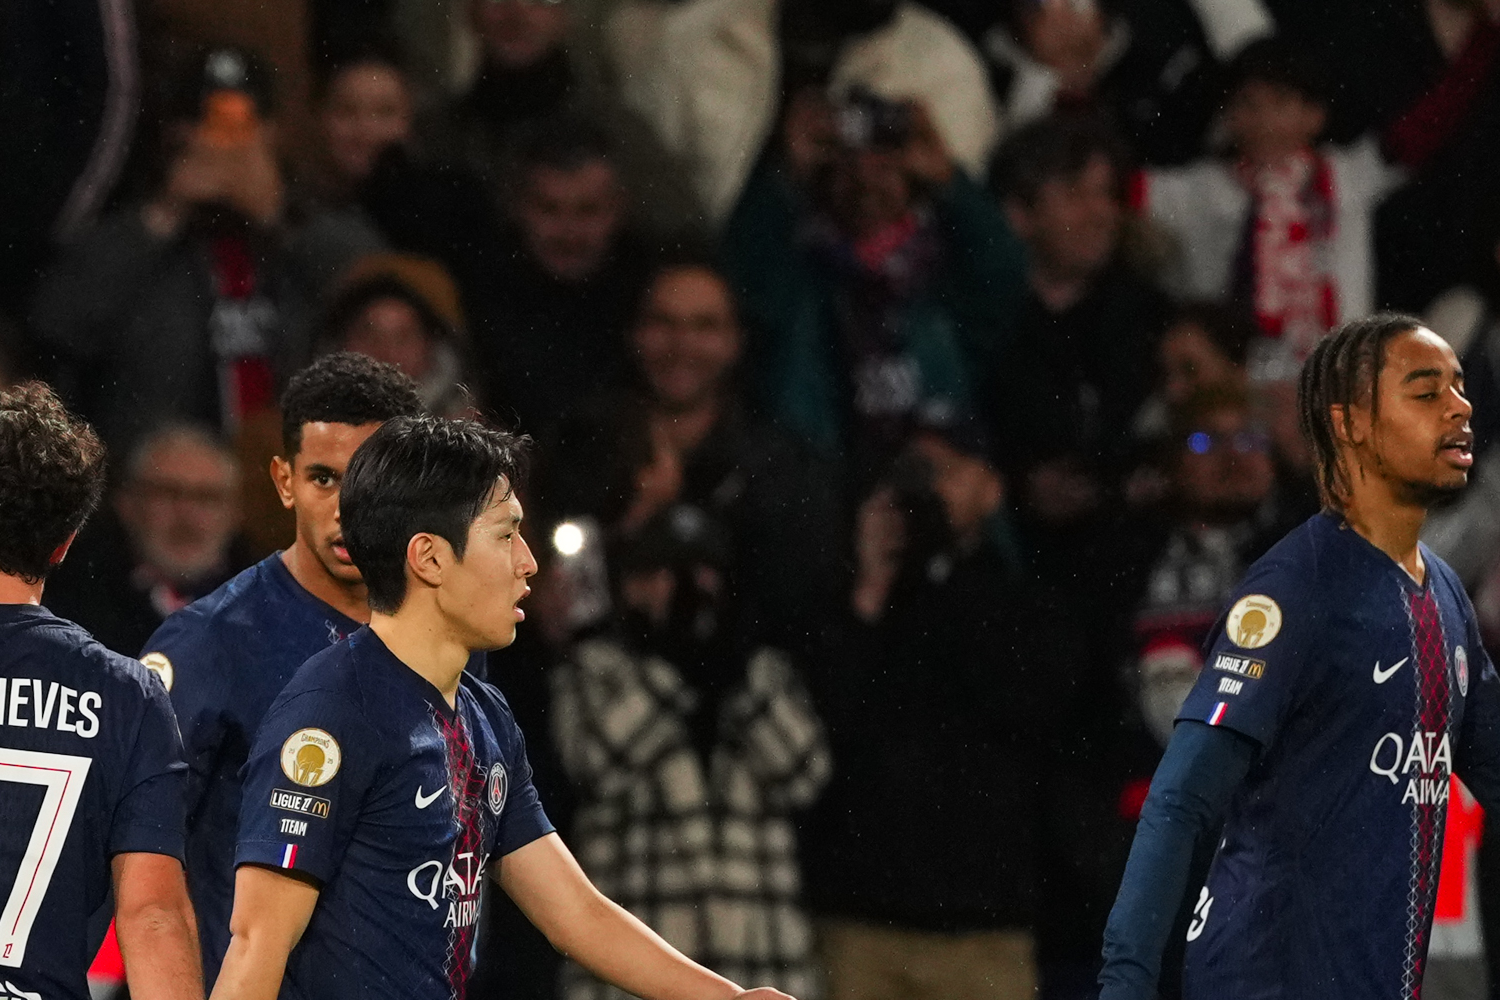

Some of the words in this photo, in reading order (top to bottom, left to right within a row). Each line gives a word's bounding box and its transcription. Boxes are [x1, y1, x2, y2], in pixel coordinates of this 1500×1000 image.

[1215, 655, 1242, 673] LIGUE
[1369, 731, 1453, 785] QATA
[272, 792, 303, 810] LIGUE
[280, 819, 308, 837] 1TEAM
